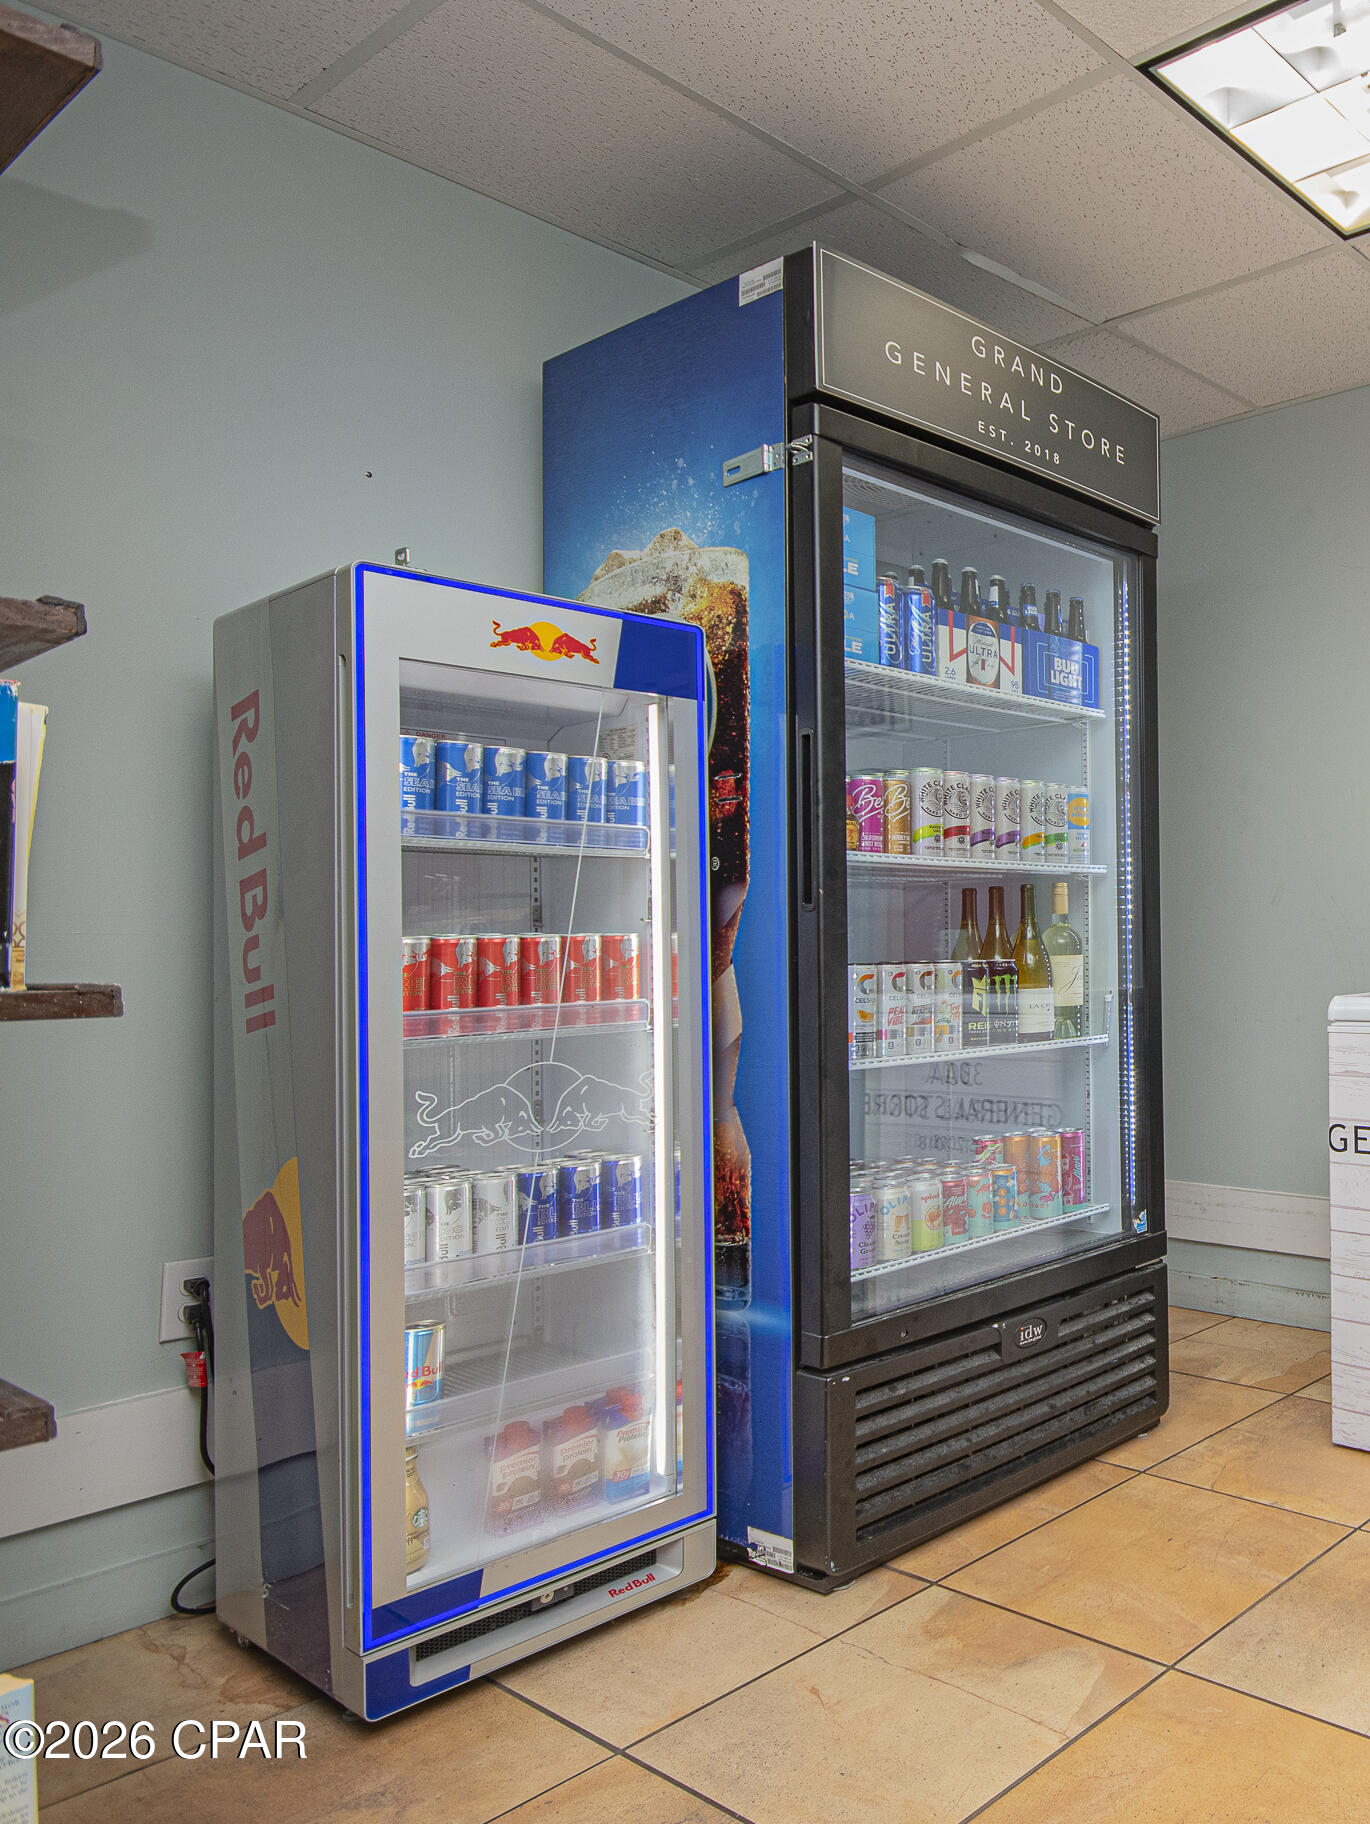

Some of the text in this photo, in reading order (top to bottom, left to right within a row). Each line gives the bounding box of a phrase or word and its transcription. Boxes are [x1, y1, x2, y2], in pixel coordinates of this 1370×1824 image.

[971, 336, 1063, 394] GRAND
[884, 341, 1125, 465] GENERAL STORE
[977, 420, 1061, 465] EST. 2018
[886, 602, 897, 655] ULTRA
[922, 611, 932, 662] ULTRA
[968, 644, 999, 659] ULTRA
[944, 666, 956, 676] 2.6
[1053, 657, 1080, 673] BUD
[1050, 669, 1083, 690] LIGHT
[404, 786, 431, 794] EDITION
[487, 794, 515, 802] EDITION
[919, 782, 932, 803] WHITE
[943, 782, 969, 806] WHITE CLA
[975, 788, 989, 809] WHITE
[1055, 793, 1066, 801] CLA
[1002, 791, 1015, 812] WHITE
[1029, 794, 1041, 814] WHITE
[231, 689, 277, 1034] Red Bull
[849, 1201, 878, 1223] OLIP
[880, 1194, 909, 1216] OLIP
[1019, 1324, 1043, 1341] idw
[607, 1573, 656, 1598] Red Bull
